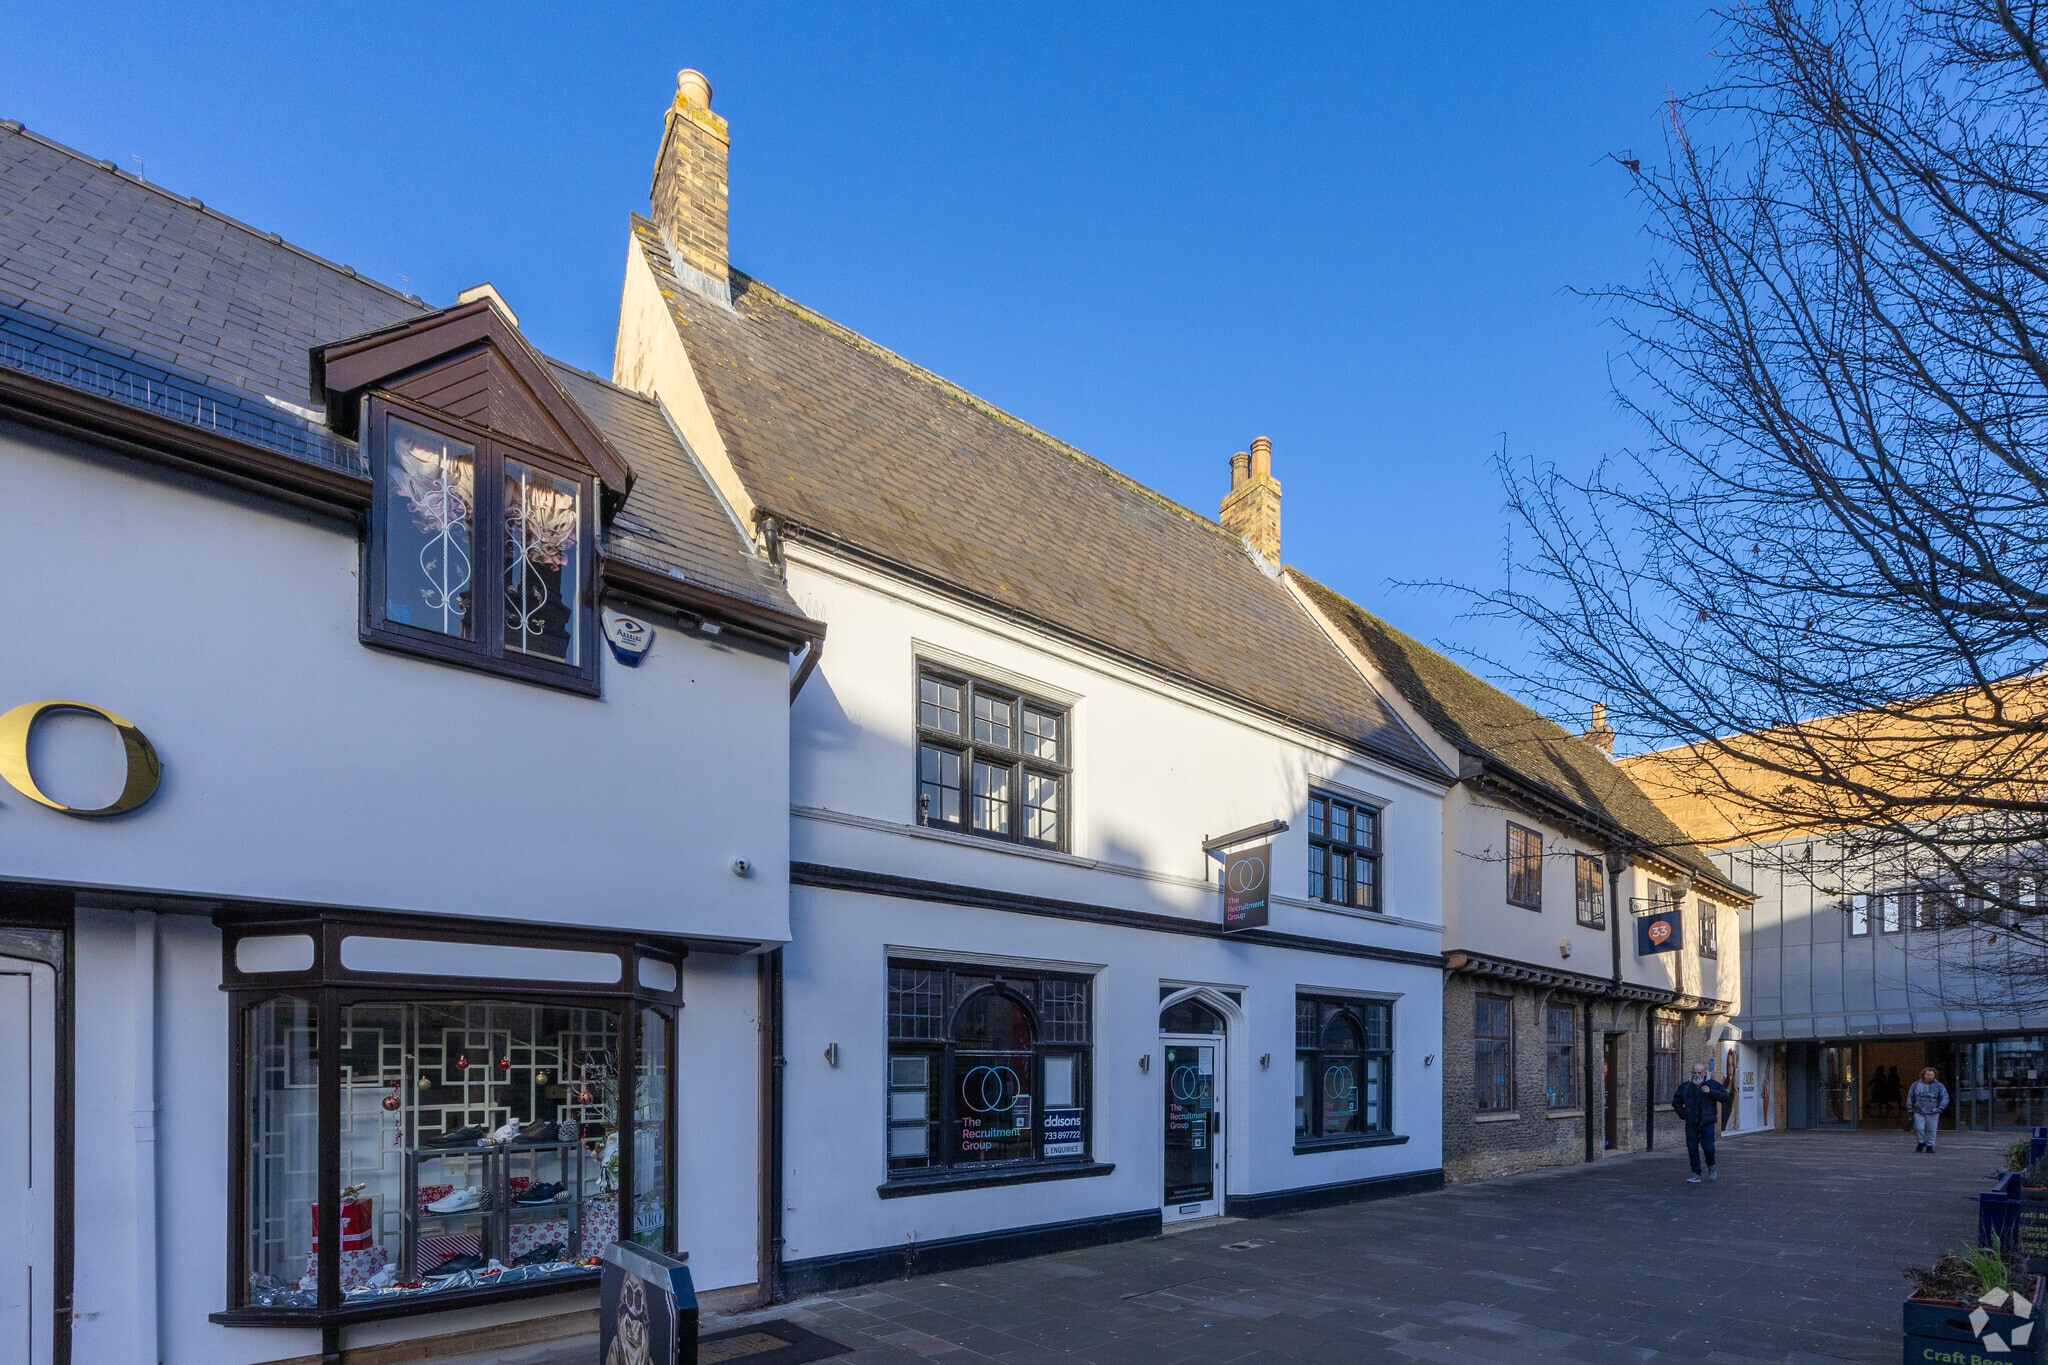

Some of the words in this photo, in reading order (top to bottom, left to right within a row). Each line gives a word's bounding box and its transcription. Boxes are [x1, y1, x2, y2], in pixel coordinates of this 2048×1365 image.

[1228, 899, 1264, 912] Recruitment
[1227, 912, 1246, 920] Group
[1652, 925, 1668, 938] 33
[1169, 1104, 1182, 1112] The
[1044, 1115, 1081, 1127] ddisons
[1169, 1112, 1207, 1121] Recruitment
[962, 1117, 982, 1127] The
[1169, 1122, 1190, 1130] Group
[962, 1128, 1021, 1139] Recruitment
[962, 1141, 992, 1151] Group
[1050, 1145, 1079, 1154] ENQUIRIES
[2020, 1211, 2037, 1219] raft
[1923, 1348, 1965, 1365] Craft
